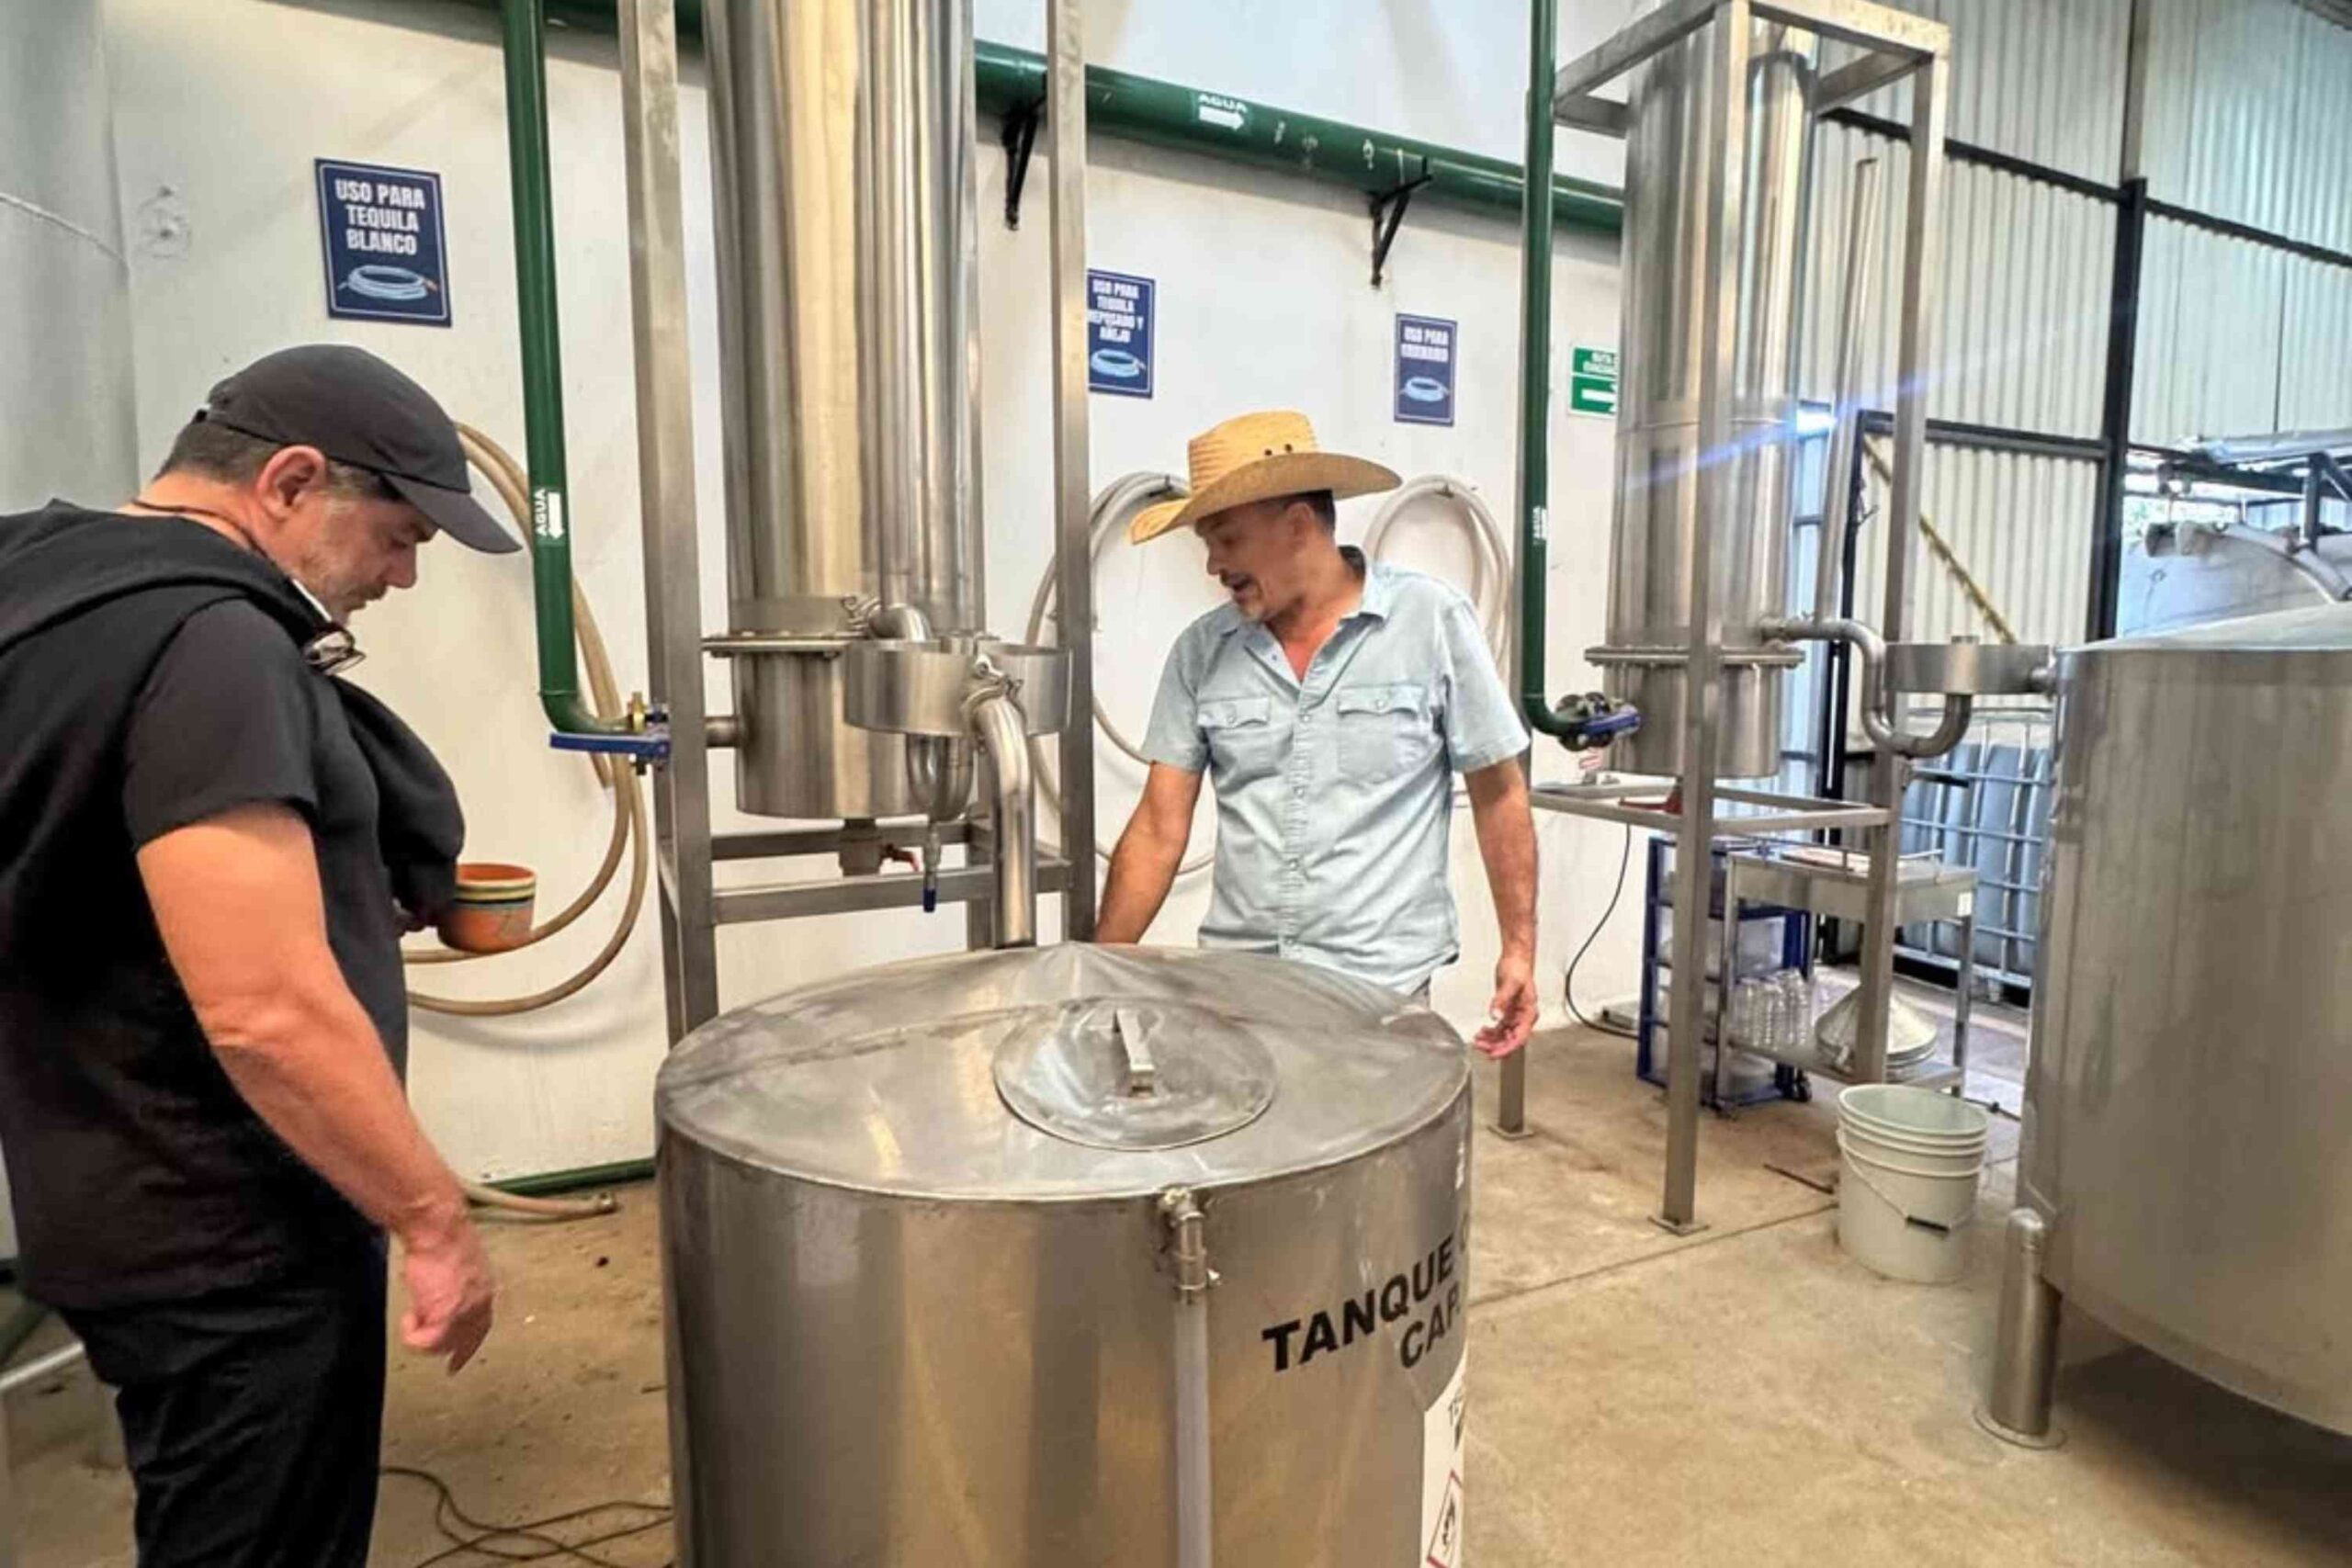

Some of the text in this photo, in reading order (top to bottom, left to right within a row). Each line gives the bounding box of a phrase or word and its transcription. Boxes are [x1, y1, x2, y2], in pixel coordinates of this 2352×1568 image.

[1198, 94, 1248, 114] AGUA
[334, 178, 426, 209] USO PARA
[345, 204, 420, 232] TEQUILA
[345, 228, 417, 256] BLANCO
[534, 488, 548, 536] AGUA
[1261, 1232, 1455, 1372] TANQUE
